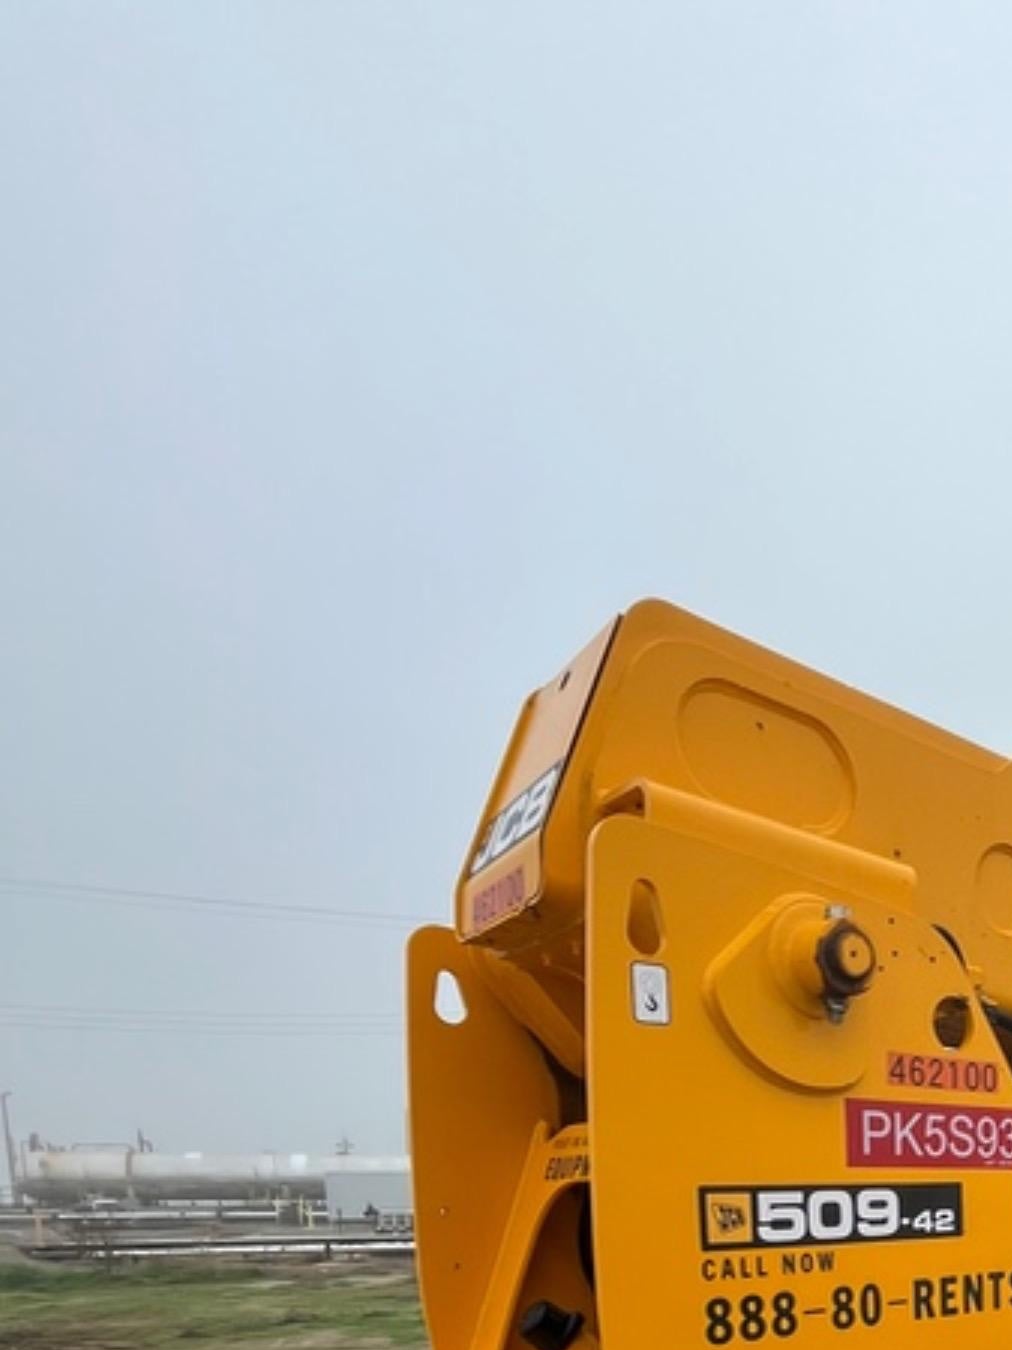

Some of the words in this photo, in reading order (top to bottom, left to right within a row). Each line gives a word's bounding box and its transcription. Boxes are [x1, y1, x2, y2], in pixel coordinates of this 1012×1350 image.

[888, 1054, 998, 1093] 462100
[700, 1255, 769, 1281] CALL
[781, 1251, 836, 1275] NOW
